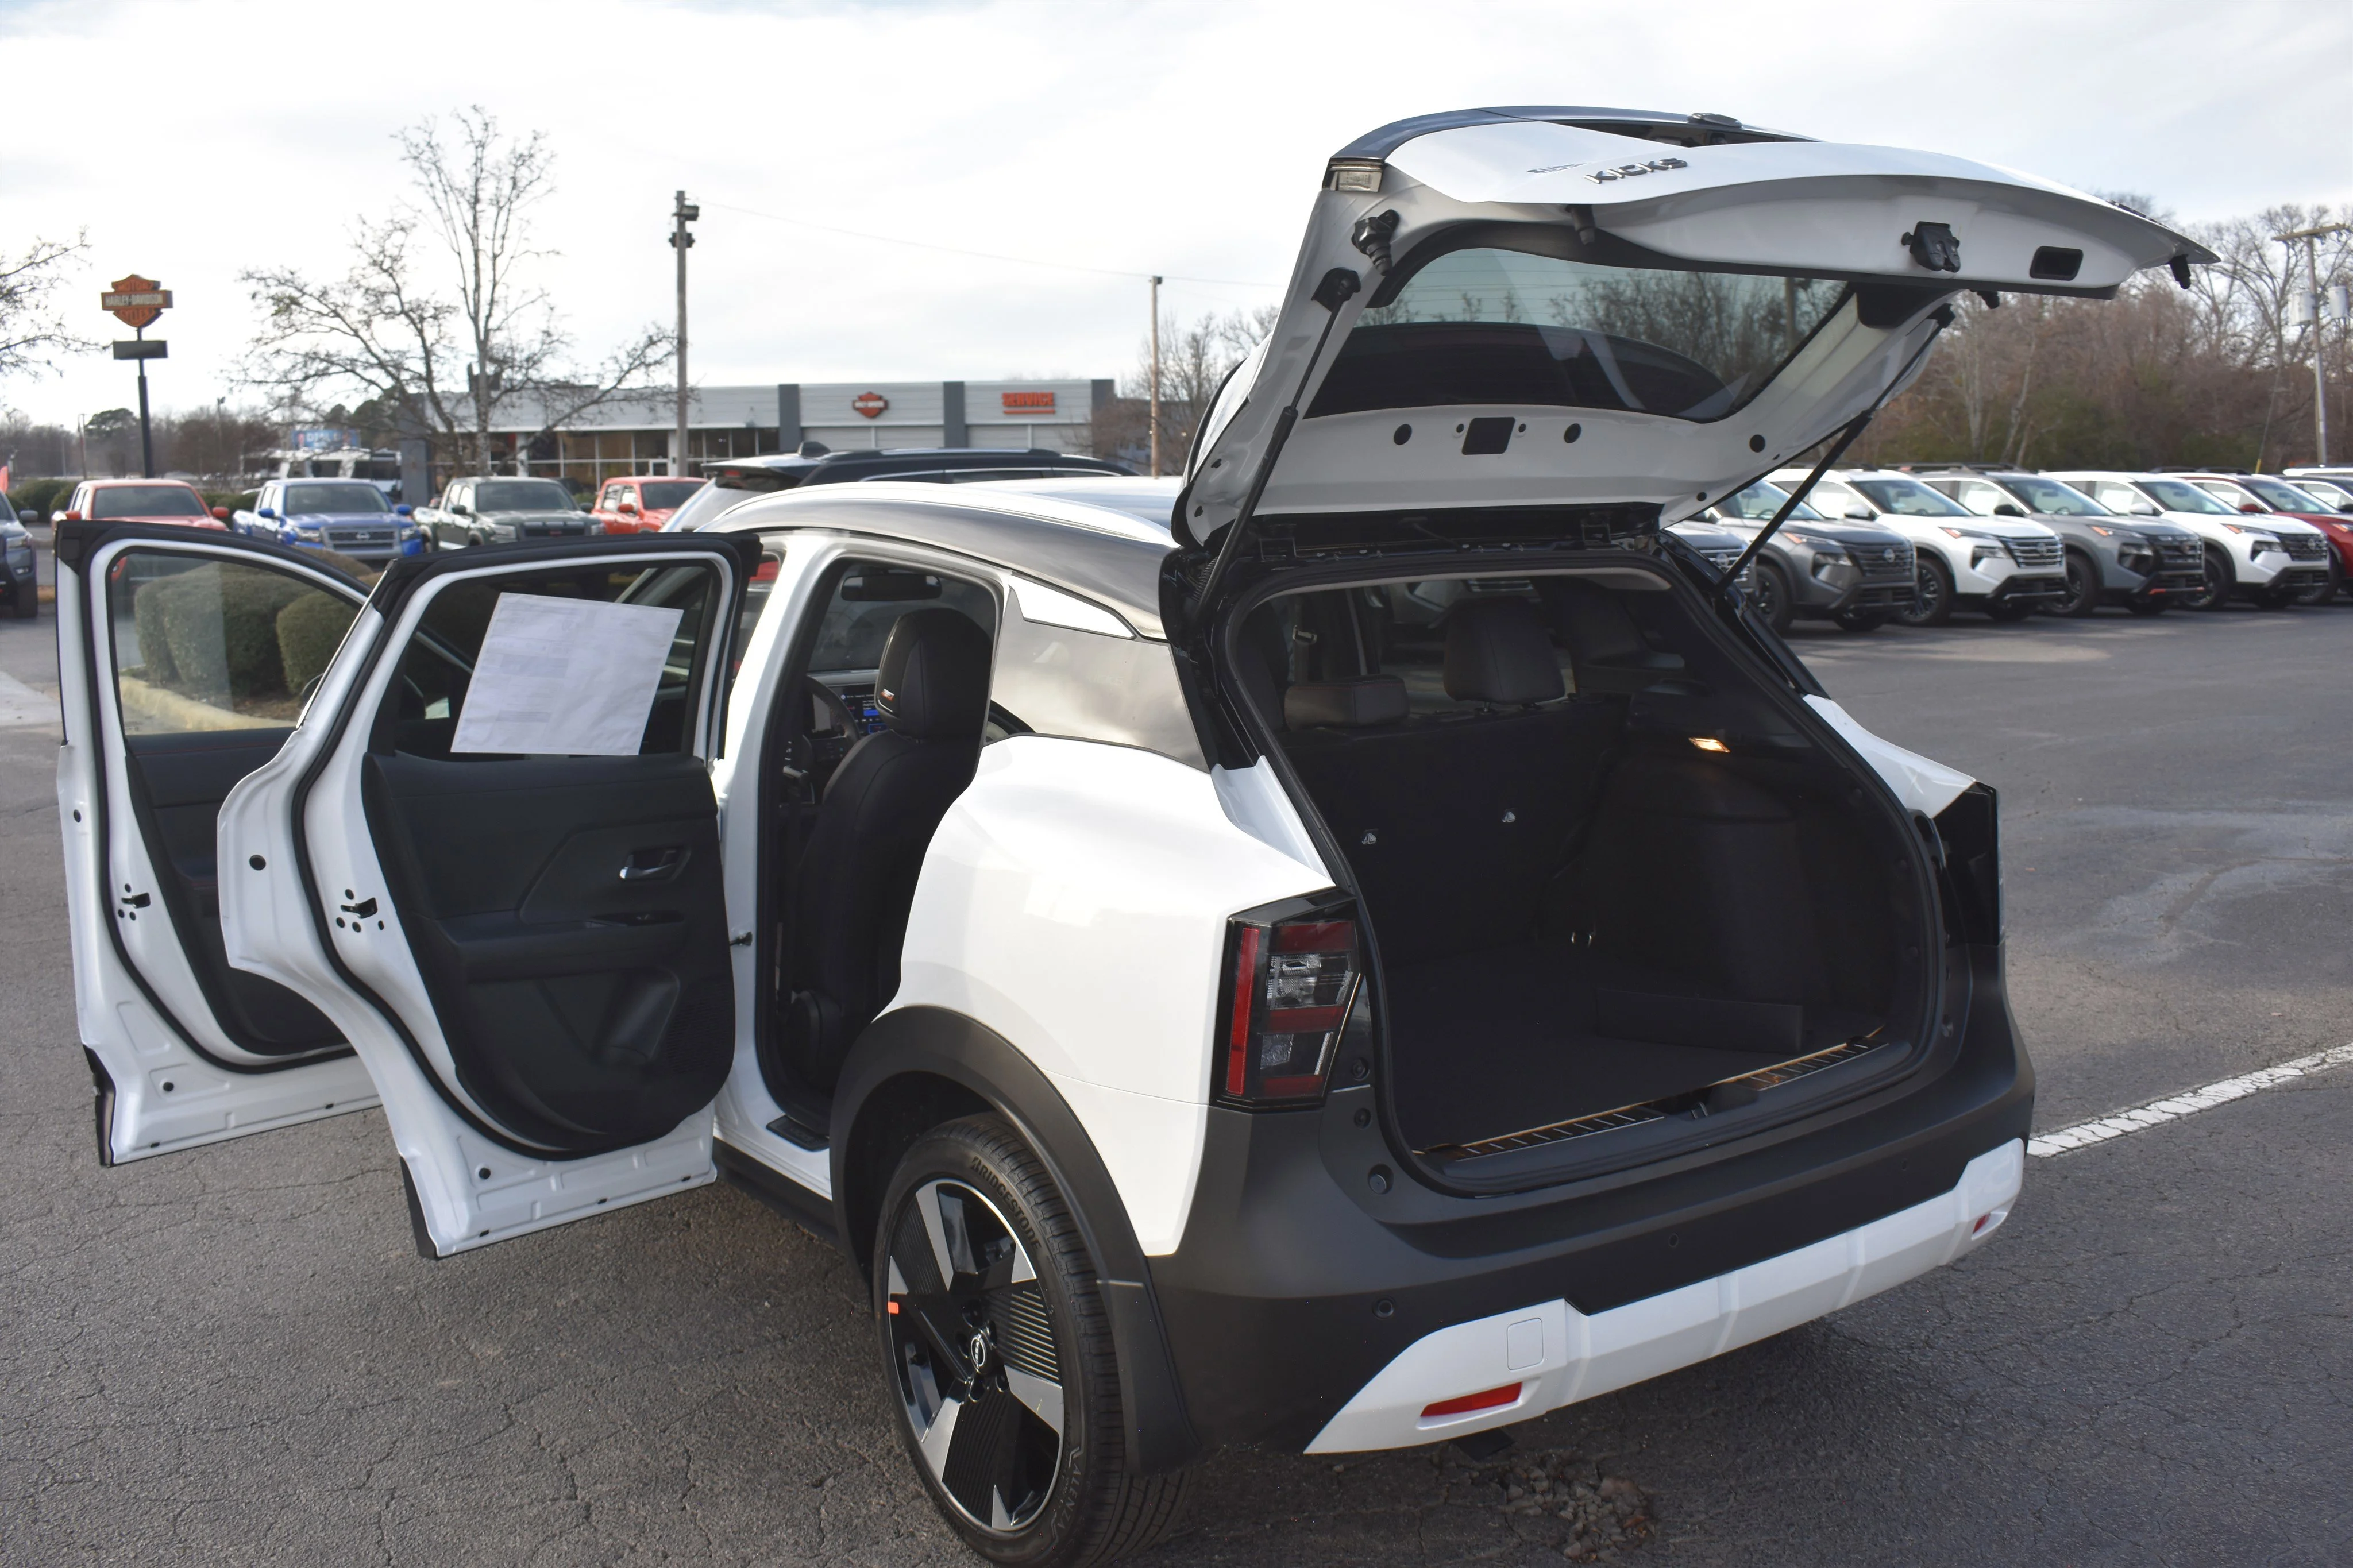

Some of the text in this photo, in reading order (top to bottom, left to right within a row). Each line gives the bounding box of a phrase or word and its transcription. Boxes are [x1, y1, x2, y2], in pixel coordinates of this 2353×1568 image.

[1583, 157, 1688, 184] KICKS
[105, 293, 164, 306] HARLEY-DAVIDSON
[1002, 392, 1054, 407] SERVICE
[970, 1156, 1042, 1249] BRIDGESTONE
[1057, 1463, 1082, 1530] ALENZA
